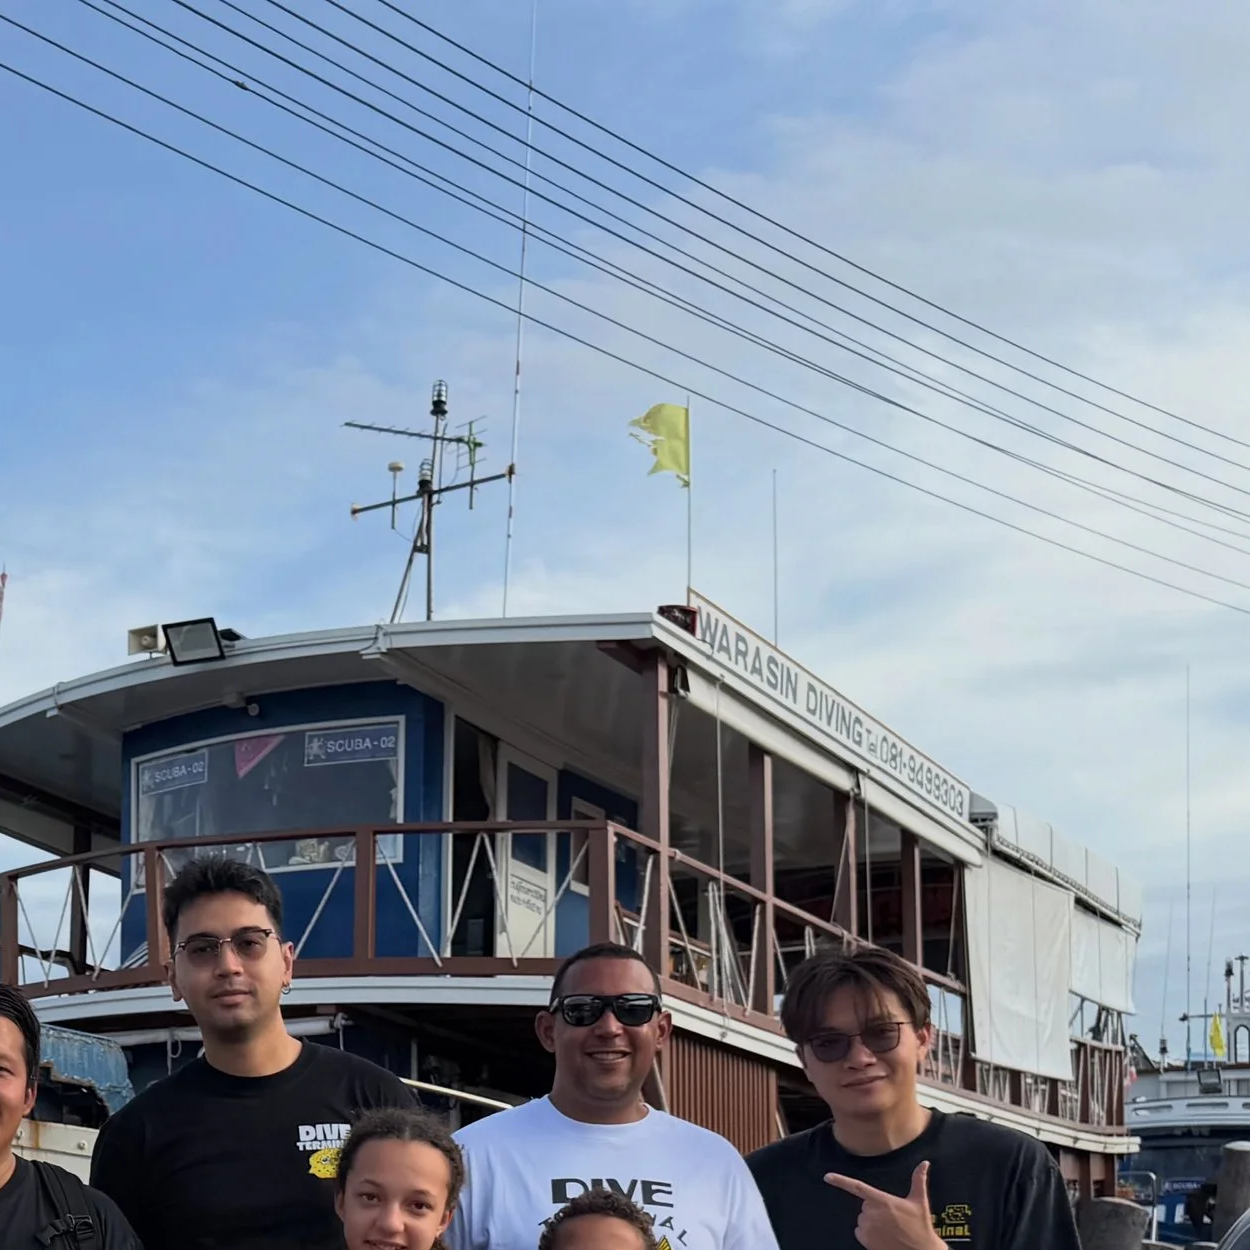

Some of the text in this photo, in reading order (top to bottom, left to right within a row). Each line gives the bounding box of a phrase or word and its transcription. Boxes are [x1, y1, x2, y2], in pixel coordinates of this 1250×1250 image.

[698, 605, 798, 704] WARASIN
[806, 682, 863, 748] DIVING
[326, 736, 396, 753] SCUBA-02
[155, 761, 204, 783] SCUBA-02
[298, 1123, 351, 1142] DIVE
[296, 1139, 344, 1151] TERMIN
